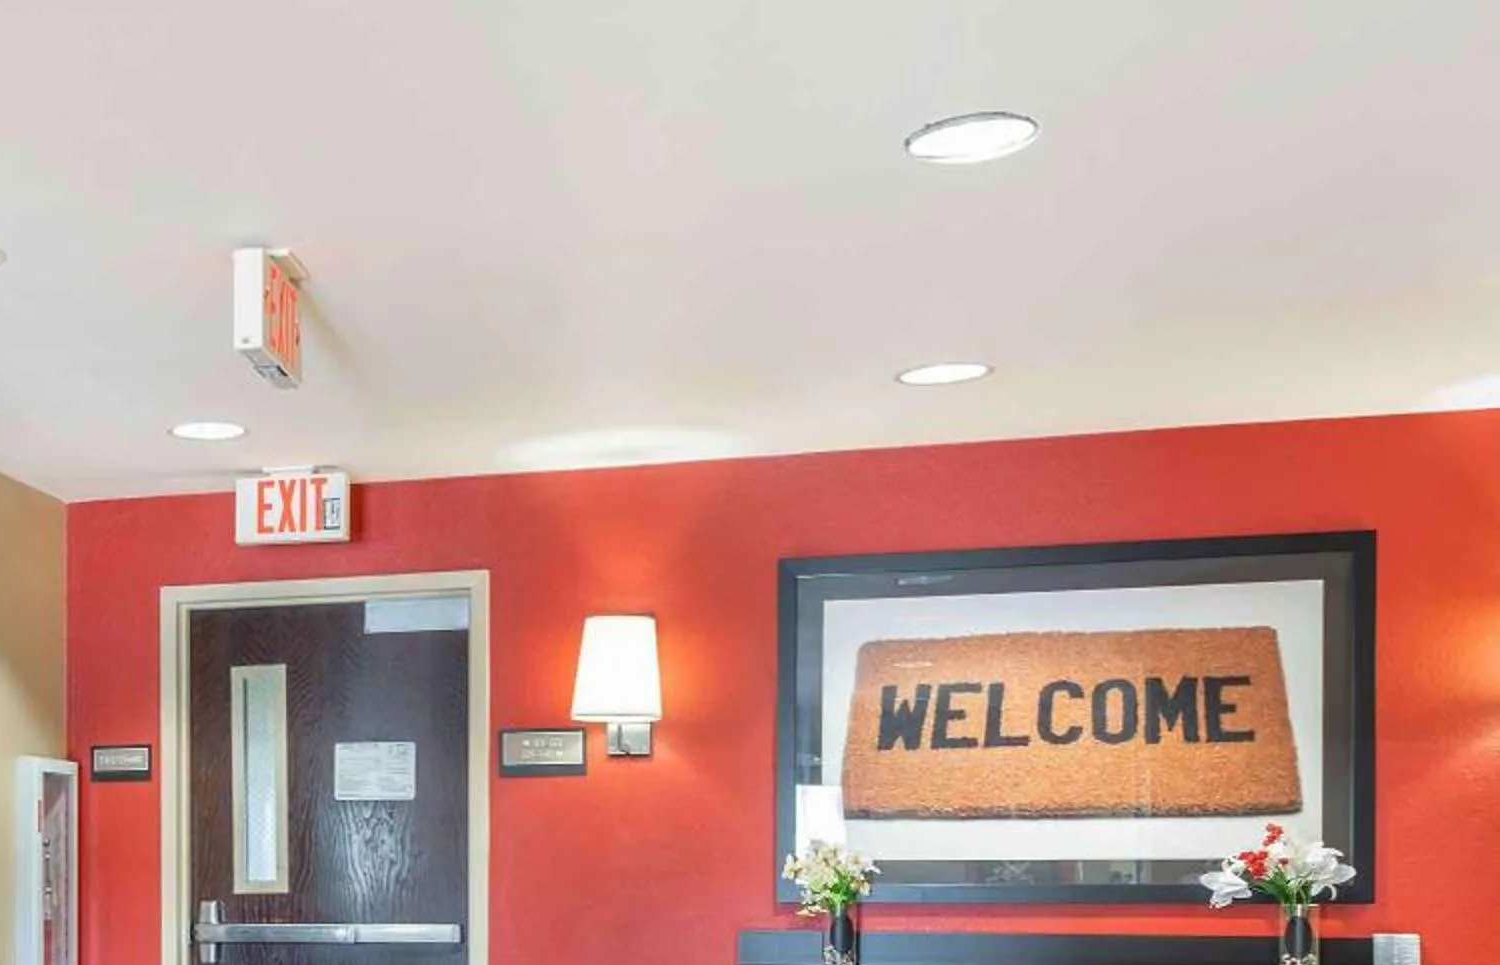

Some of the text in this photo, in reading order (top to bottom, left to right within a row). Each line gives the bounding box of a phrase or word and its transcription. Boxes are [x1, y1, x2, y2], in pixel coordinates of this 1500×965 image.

[268, 263, 298, 370] EXIT
[257, 478, 327, 533] EXIT
[878, 675, 1255, 750] WELCOME
